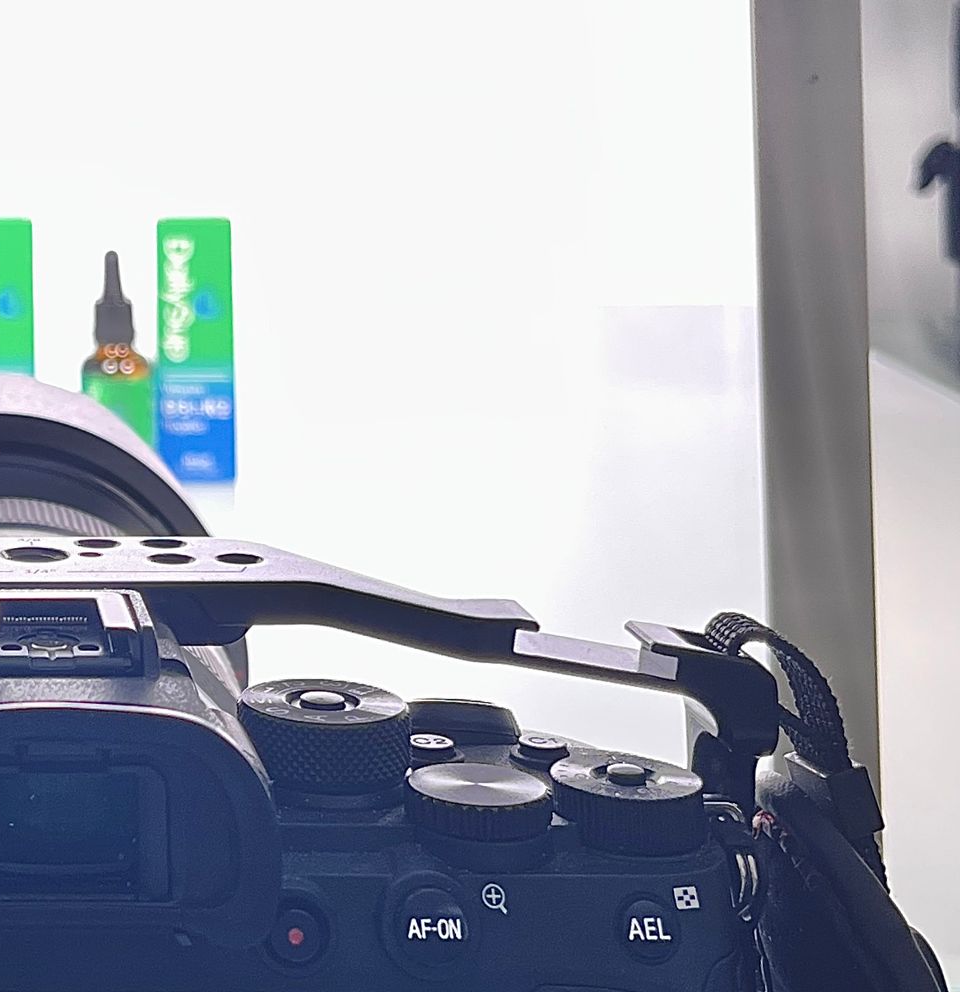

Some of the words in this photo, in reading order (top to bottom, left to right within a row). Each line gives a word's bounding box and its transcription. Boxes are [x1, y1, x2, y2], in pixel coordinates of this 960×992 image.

[412, 737, 449, 745] C2
[527, 736, 560, 744] C1
[408, 918, 461, 940] AF-ON
[628, 918, 671, 941] AEL
